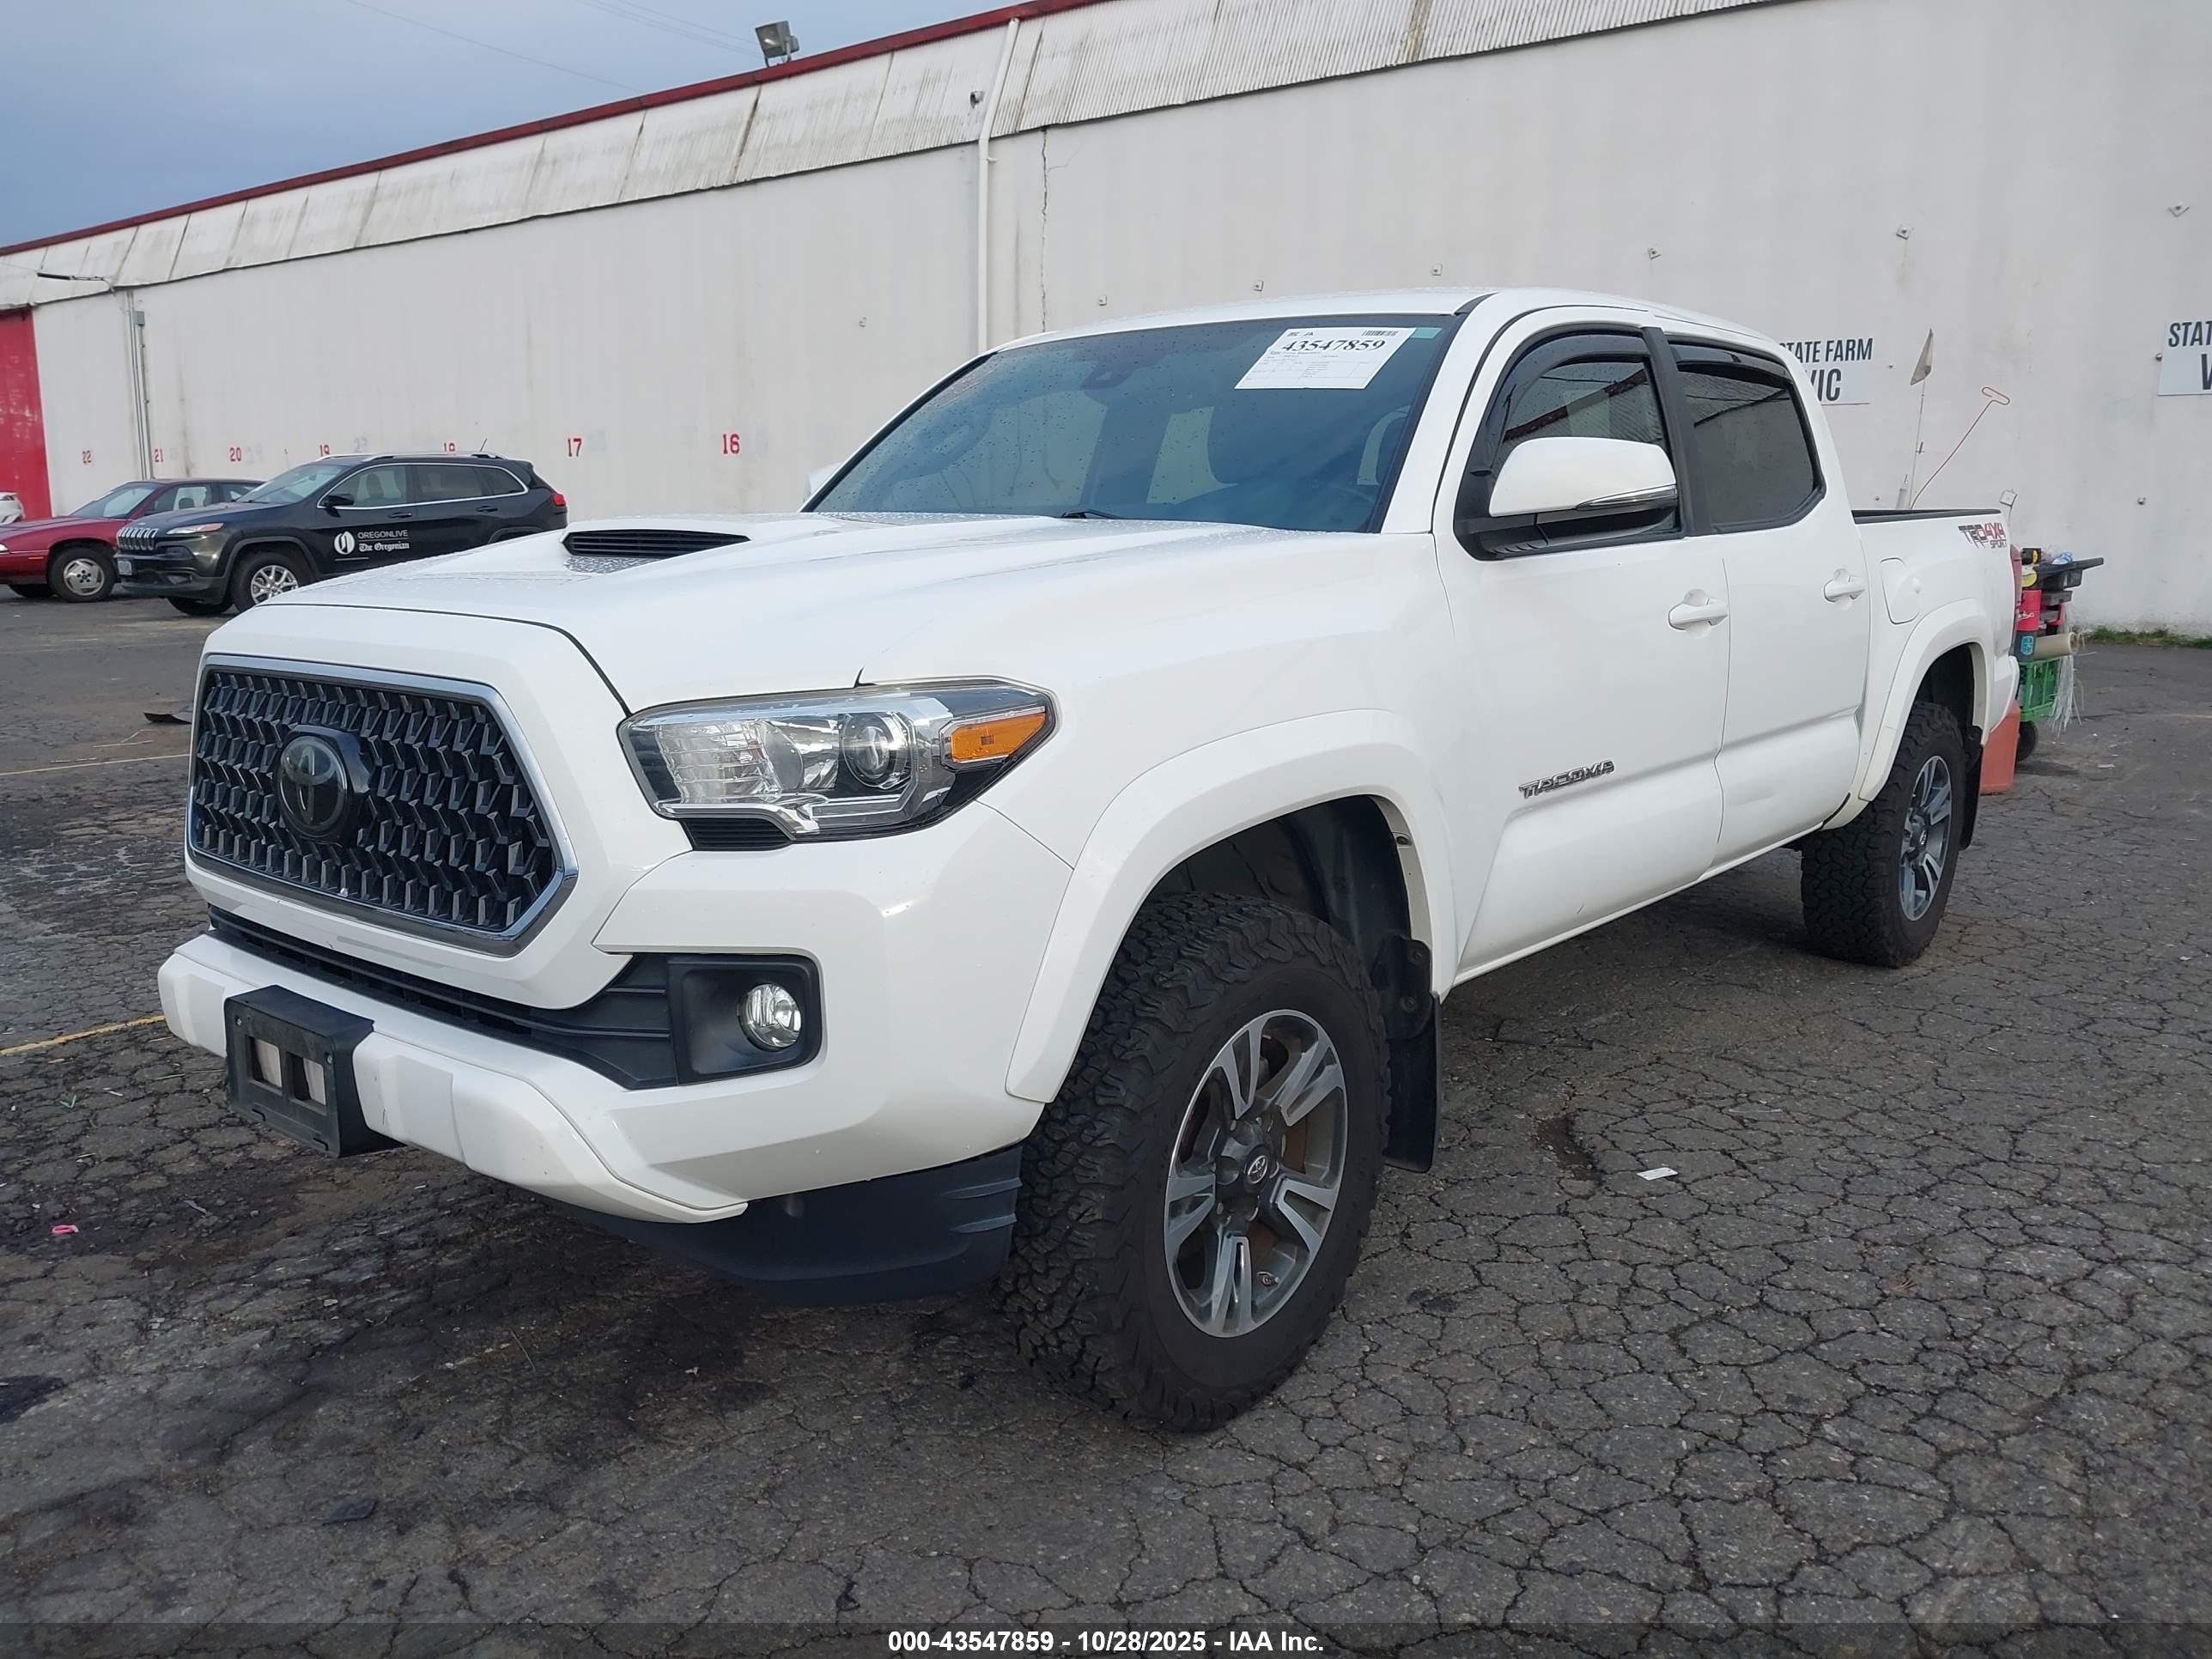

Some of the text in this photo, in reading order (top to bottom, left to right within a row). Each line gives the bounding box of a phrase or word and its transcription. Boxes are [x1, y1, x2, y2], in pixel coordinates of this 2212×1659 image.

[1282, 339, 1386, 351] 43547859
[1826, 337, 1873, 362] FARM
[568, 438, 581, 457] 17
[722, 434, 739, 454] 16
[154, 448, 164, 463] 21
[229, 447, 241, 462] 20
[357, 530, 408, 539] OREGONLIVE
[374, 541, 410, 551] Oregonian
[1518, 760, 1614, 799] TACOMA
